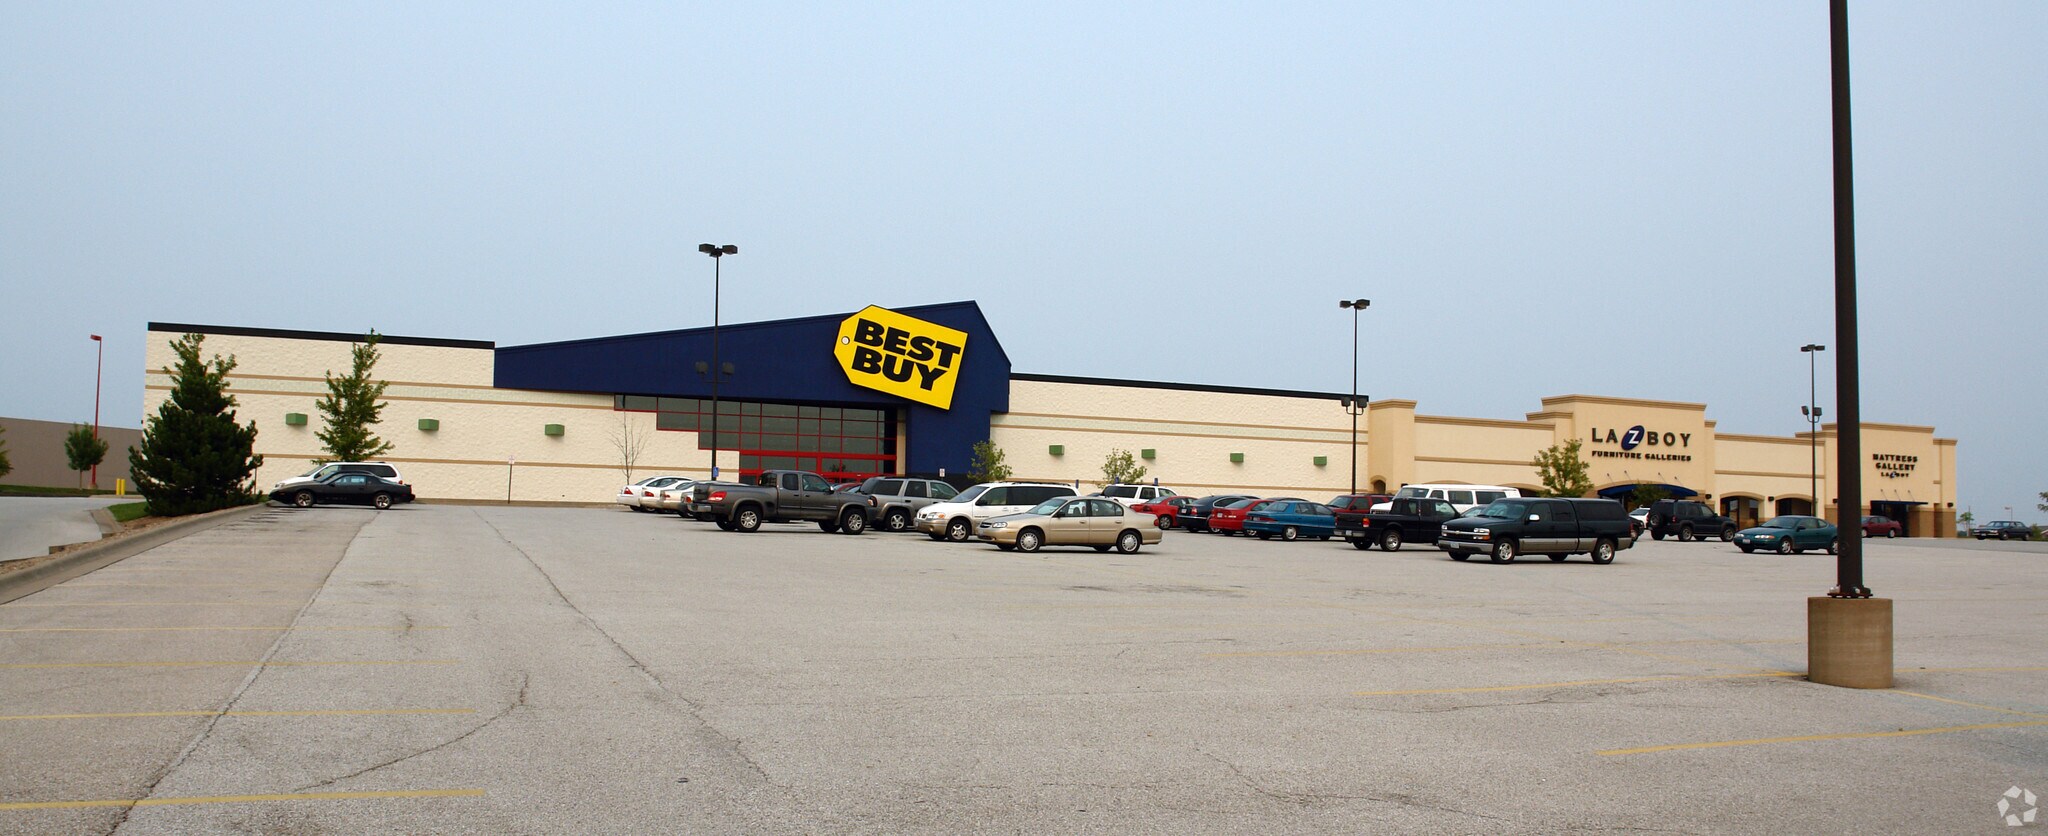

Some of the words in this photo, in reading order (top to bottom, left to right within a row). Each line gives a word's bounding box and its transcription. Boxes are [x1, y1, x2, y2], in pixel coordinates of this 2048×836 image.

[854, 318, 961, 368] BEST
[852, 345, 948, 391] BUY
[1592, 450, 1642, 460] FURNITURE
[1645, 453, 1692, 462] GALLERIES
[1872, 453, 1918, 463] MATTRESS
[1875, 462, 1915, 471] GALLERY
